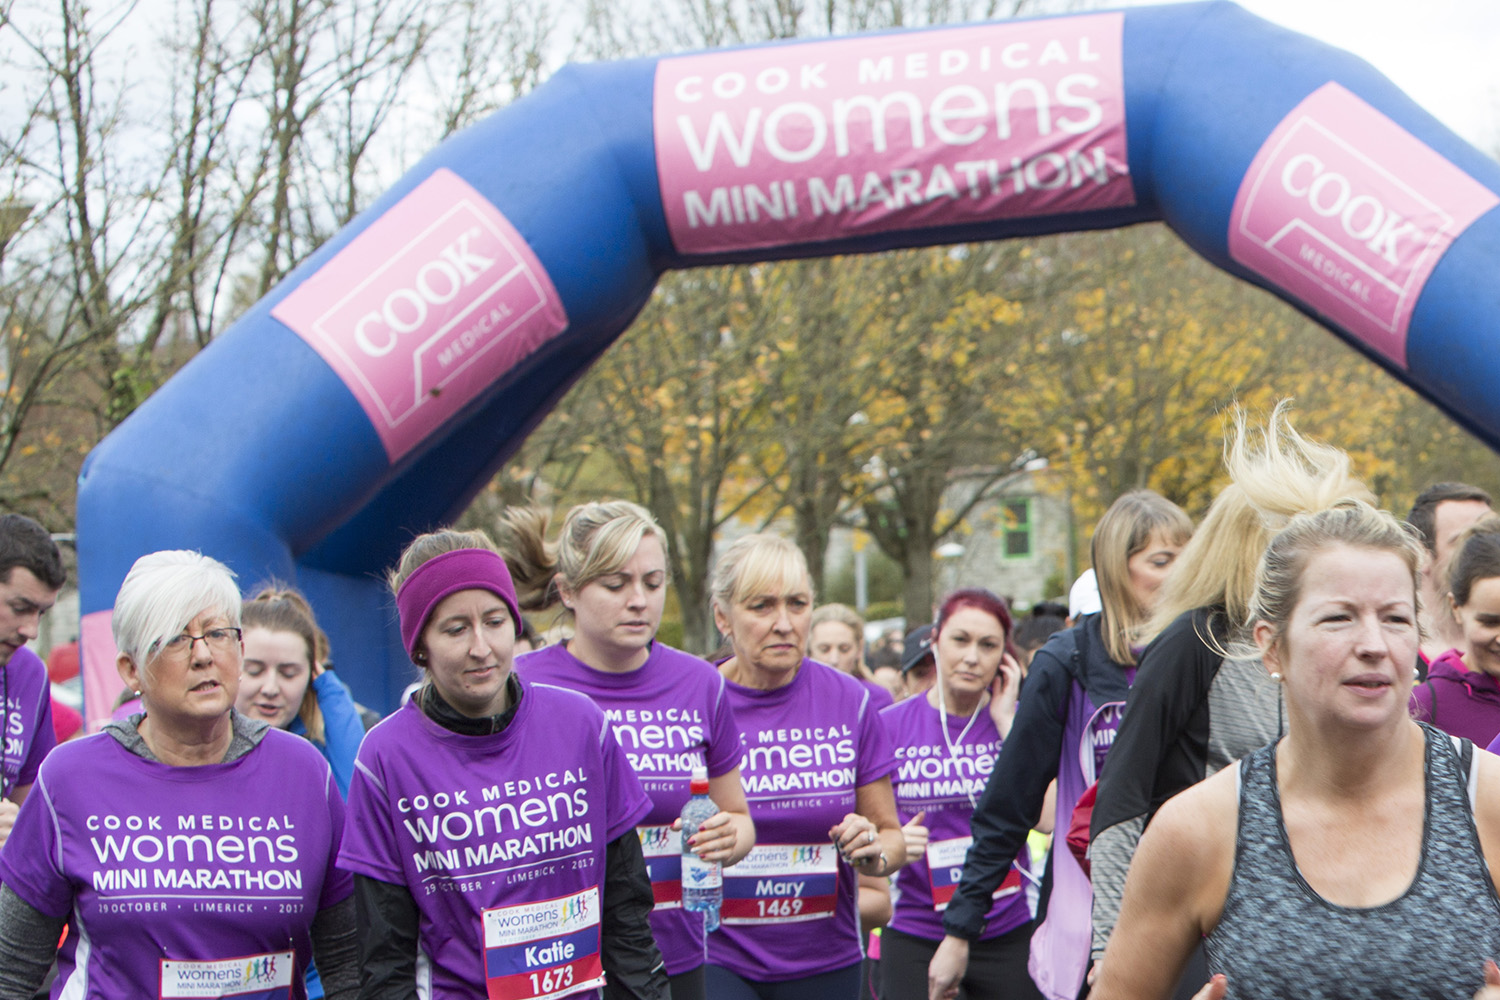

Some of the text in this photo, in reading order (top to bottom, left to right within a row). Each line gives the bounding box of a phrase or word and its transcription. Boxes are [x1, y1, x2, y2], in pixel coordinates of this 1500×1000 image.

[674, 36, 1099, 102] COOK MEDICAL
[677, 72, 1103, 173] womens
[683, 147, 1108, 228] MINI MARATHON
[1281, 153, 1414, 266] COOK
[1299, 243, 1371, 303] MEDICAL
[354, 232, 495, 358] COOK
[437, 301, 513, 368] MEDICAL
[606, 708, 702, 722] MEDICAL
[612, 725, 704, 749] mens
[758, 724, 852, 743] MEDICAL
[625, 751, 705, 772] RATHON
[739, 739, 856, 771] mens
[894, 740, 1003, 759] COOK MEDIC
[898, 753, 999, 781] wome
[397, 767, 588, 813] COOK MEDICAL
[644, 783, 674, 792] ERICK
[897, 777, 990, 797] MINI MARA
[86, 815, 294, 831] COOK MEDICAL
[403, 788, 589, 843] womens
[90, 835, 299, 864] womens
[412, 823, 592, 873] MINI MARATHON
[93, 868, 302, 891] MINI MARATHON
[507, 865, 555, 885] LIMERICK
[571, 858, 595, 870] 2017
[755, 879, 805, 898] Mary
[111, 902, 168, 913] OCTOBER
[193, 903, 253, 913] LIMERICK
[279, 904, 305, 914] 2017
[498, 908, 559, 928] womens
[757, 899, 803, 917] 1469
[518, 921, 559, 935] MARATHON
[524, 940, 575, 968] Katie
[177, 968, 242, 981] womens
[196, 981, 241, 989] MARATHON
[529, 965, 574, 995] 1673
